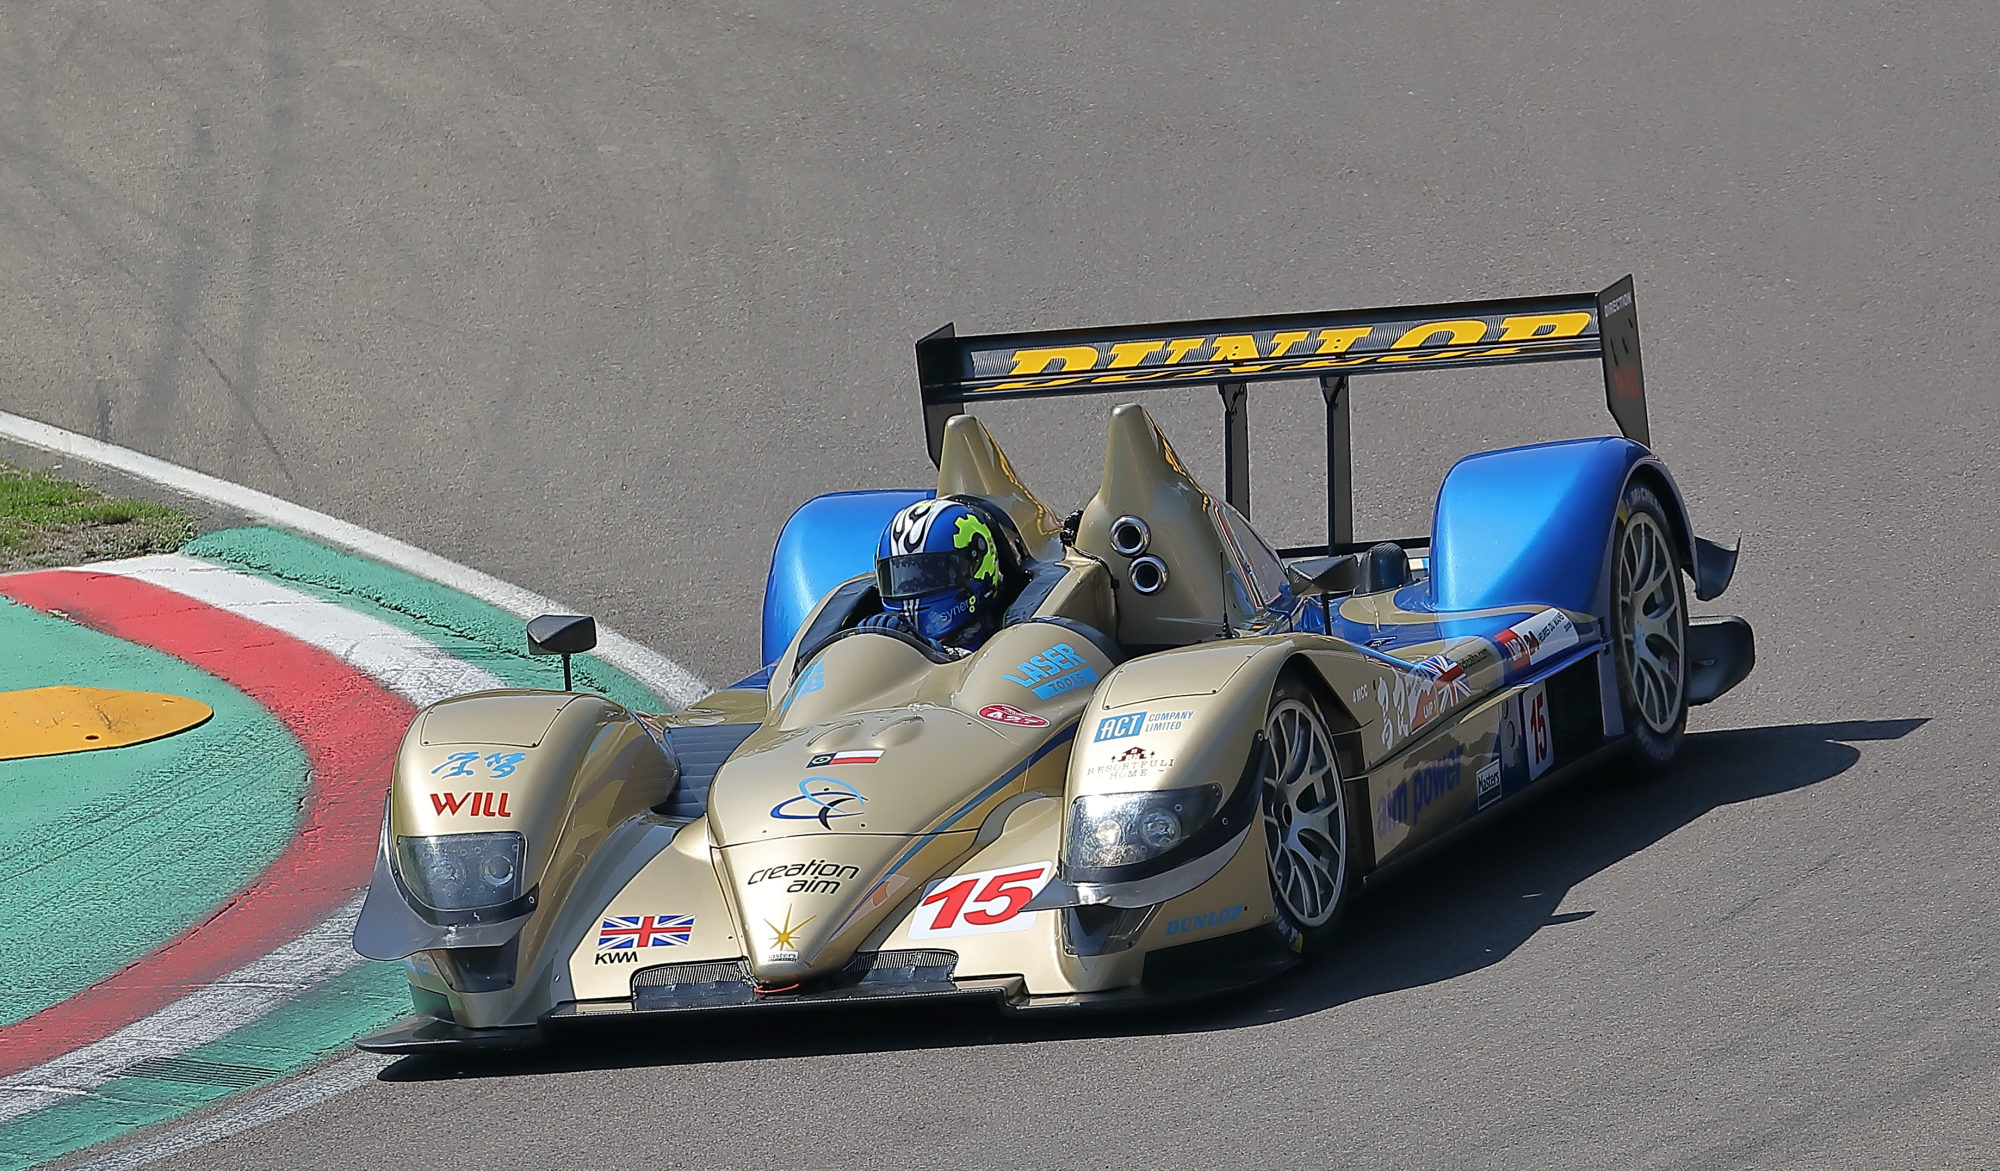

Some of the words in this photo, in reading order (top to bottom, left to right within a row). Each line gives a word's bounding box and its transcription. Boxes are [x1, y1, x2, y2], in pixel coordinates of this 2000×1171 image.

[1001, 642, 1088, 688] LASER
[1048, 671, 1086, 695] TOOLS
[1099, 714, 1142, 740] ACT
[1148, 711, 1195, 723] COMPANY
[1145, 721, 1182, 733] LIMITED
[1530, 690, 1548, 765] 15
[1109, 768, 1149, 780] HOME
[1477, 770, 1500, 795] Masters
[429, 791, 512, 818] WILL
[1376, 776, 1408, 840] aim
[1413, 743, 1465, 827] power
[747, 858, 860, 886] creation
[786, 875, 841, 896] aim
[922, 867, 1046, 931] 15
[1164, 904, 1245, 936] DUNLOP
[594, 951, 639, 966] KWM
